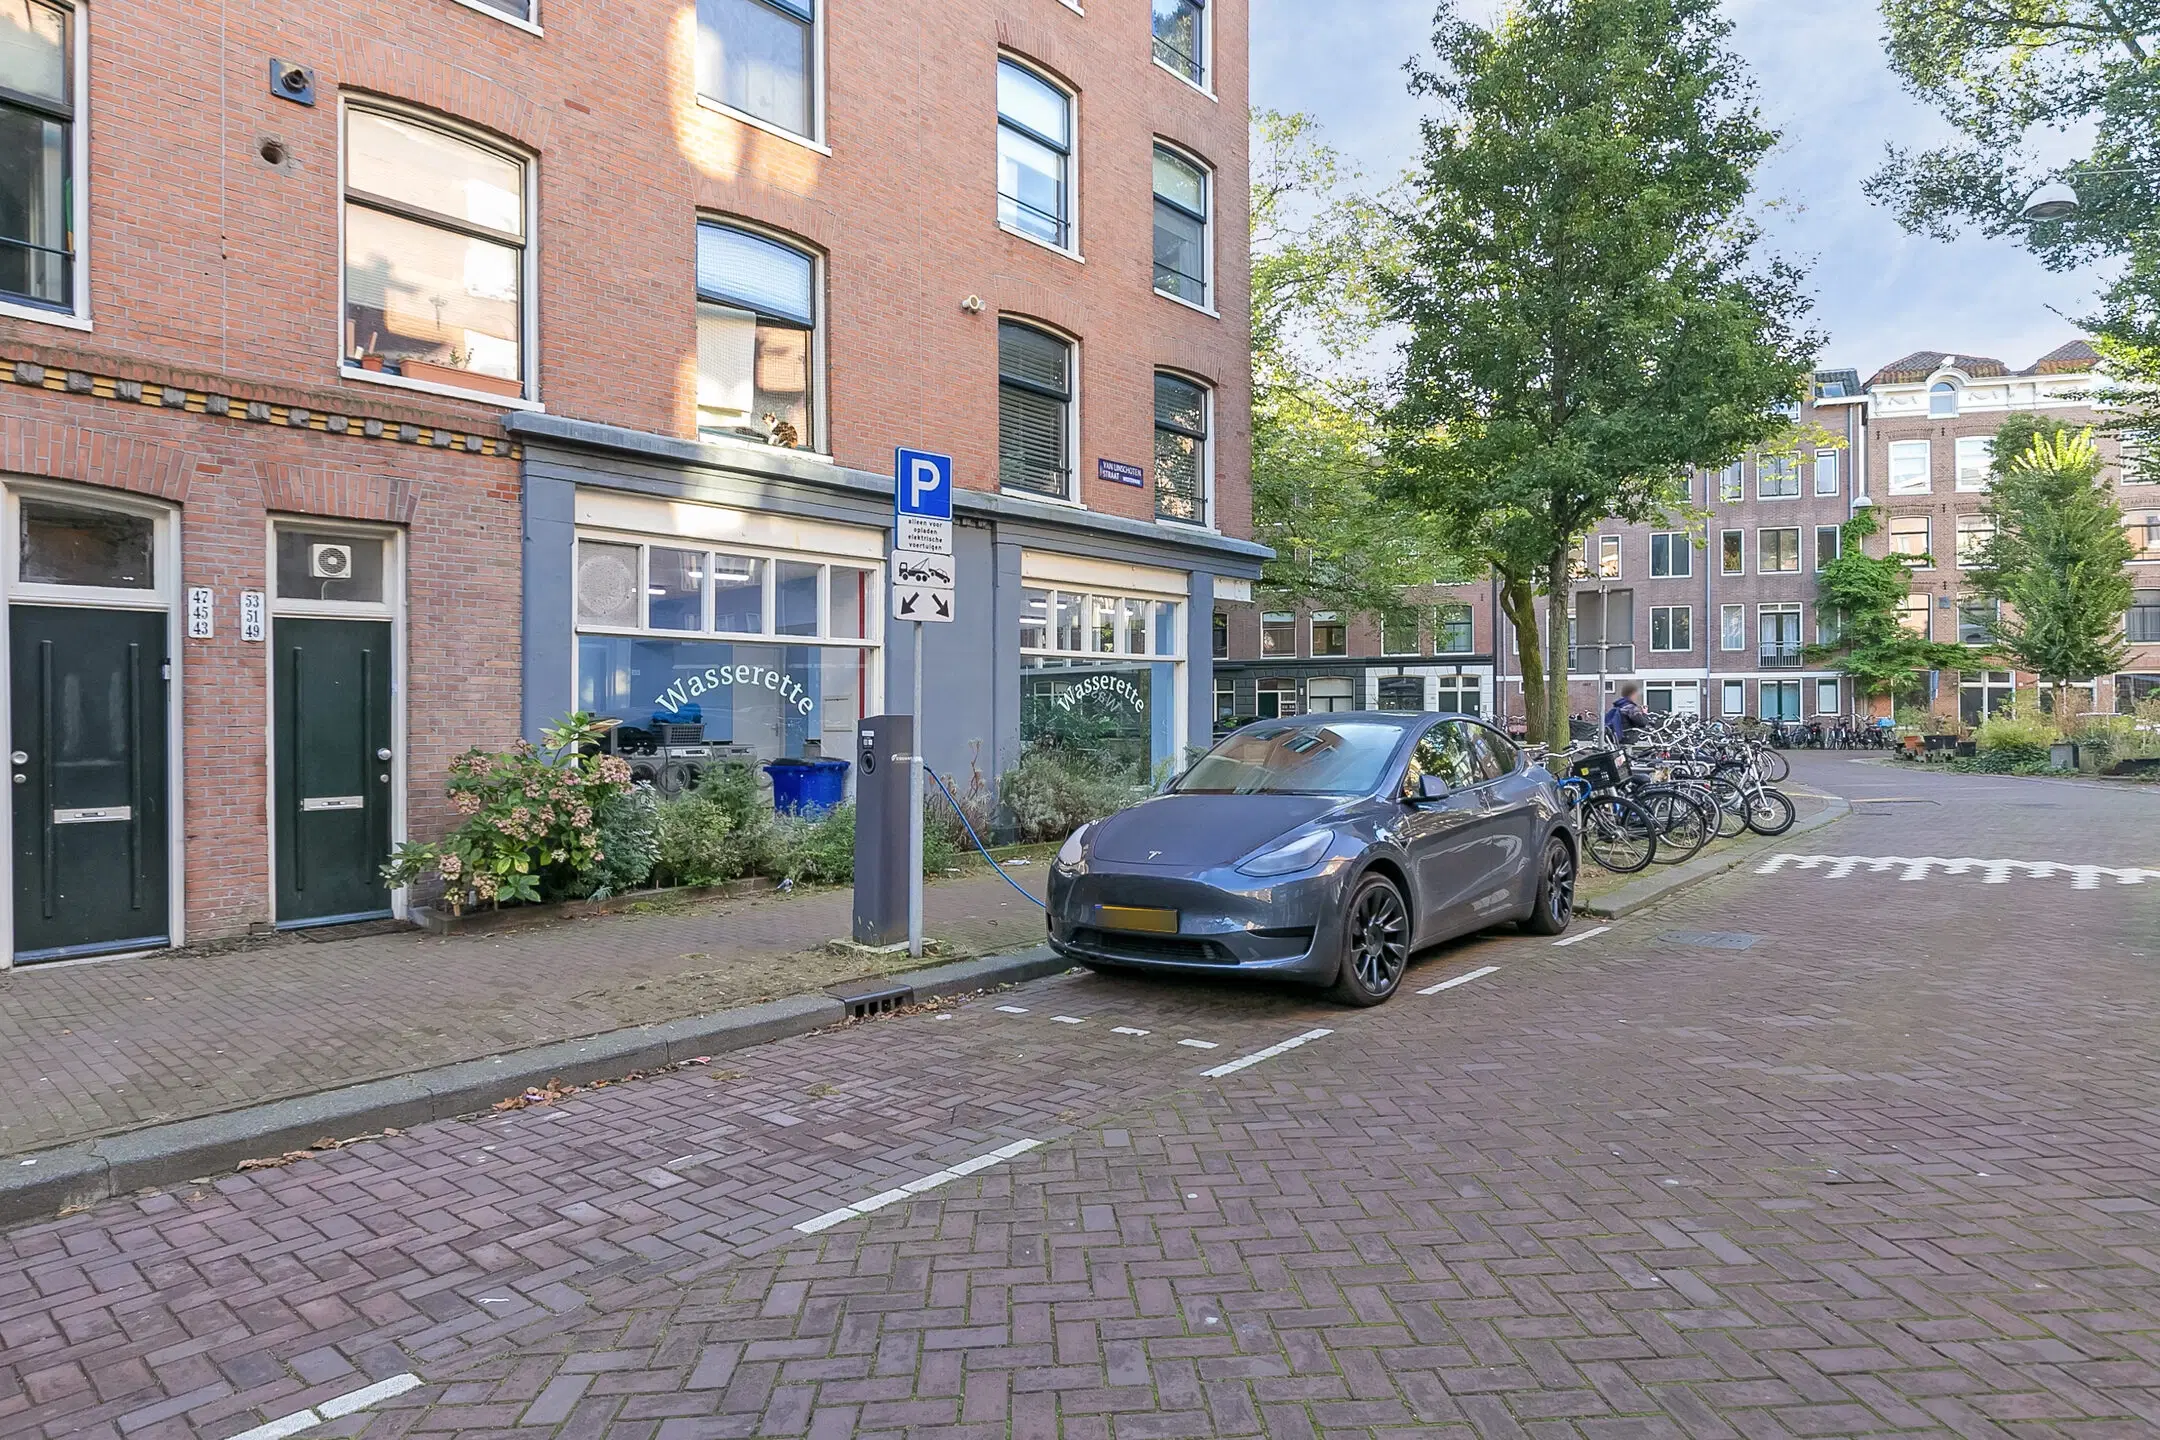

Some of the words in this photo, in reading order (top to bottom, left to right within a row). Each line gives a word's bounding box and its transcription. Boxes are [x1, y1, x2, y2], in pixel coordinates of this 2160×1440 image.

[1103, 461, 1113, 470] VAN
[1102, 470, 1120, 480] STRAAT
[911, 457, 941, 508] P
[913, 527, 938, 535] opladen
[907, 534, 943, 543] elektrische
[908, 542, 943, 551] voertuigen
[193, 590, 208, 603] 47
[245, 595, 260, 607] 53
[193, 606, 208, 619] 45
[246, 609, 259, 623] 51
[193, 621, 208, 634] 43
[245, 624, 260, 637] 49
[655, 663, 815, 716] Wasserette
[1056, 674, 1145, 713] Wasserette
